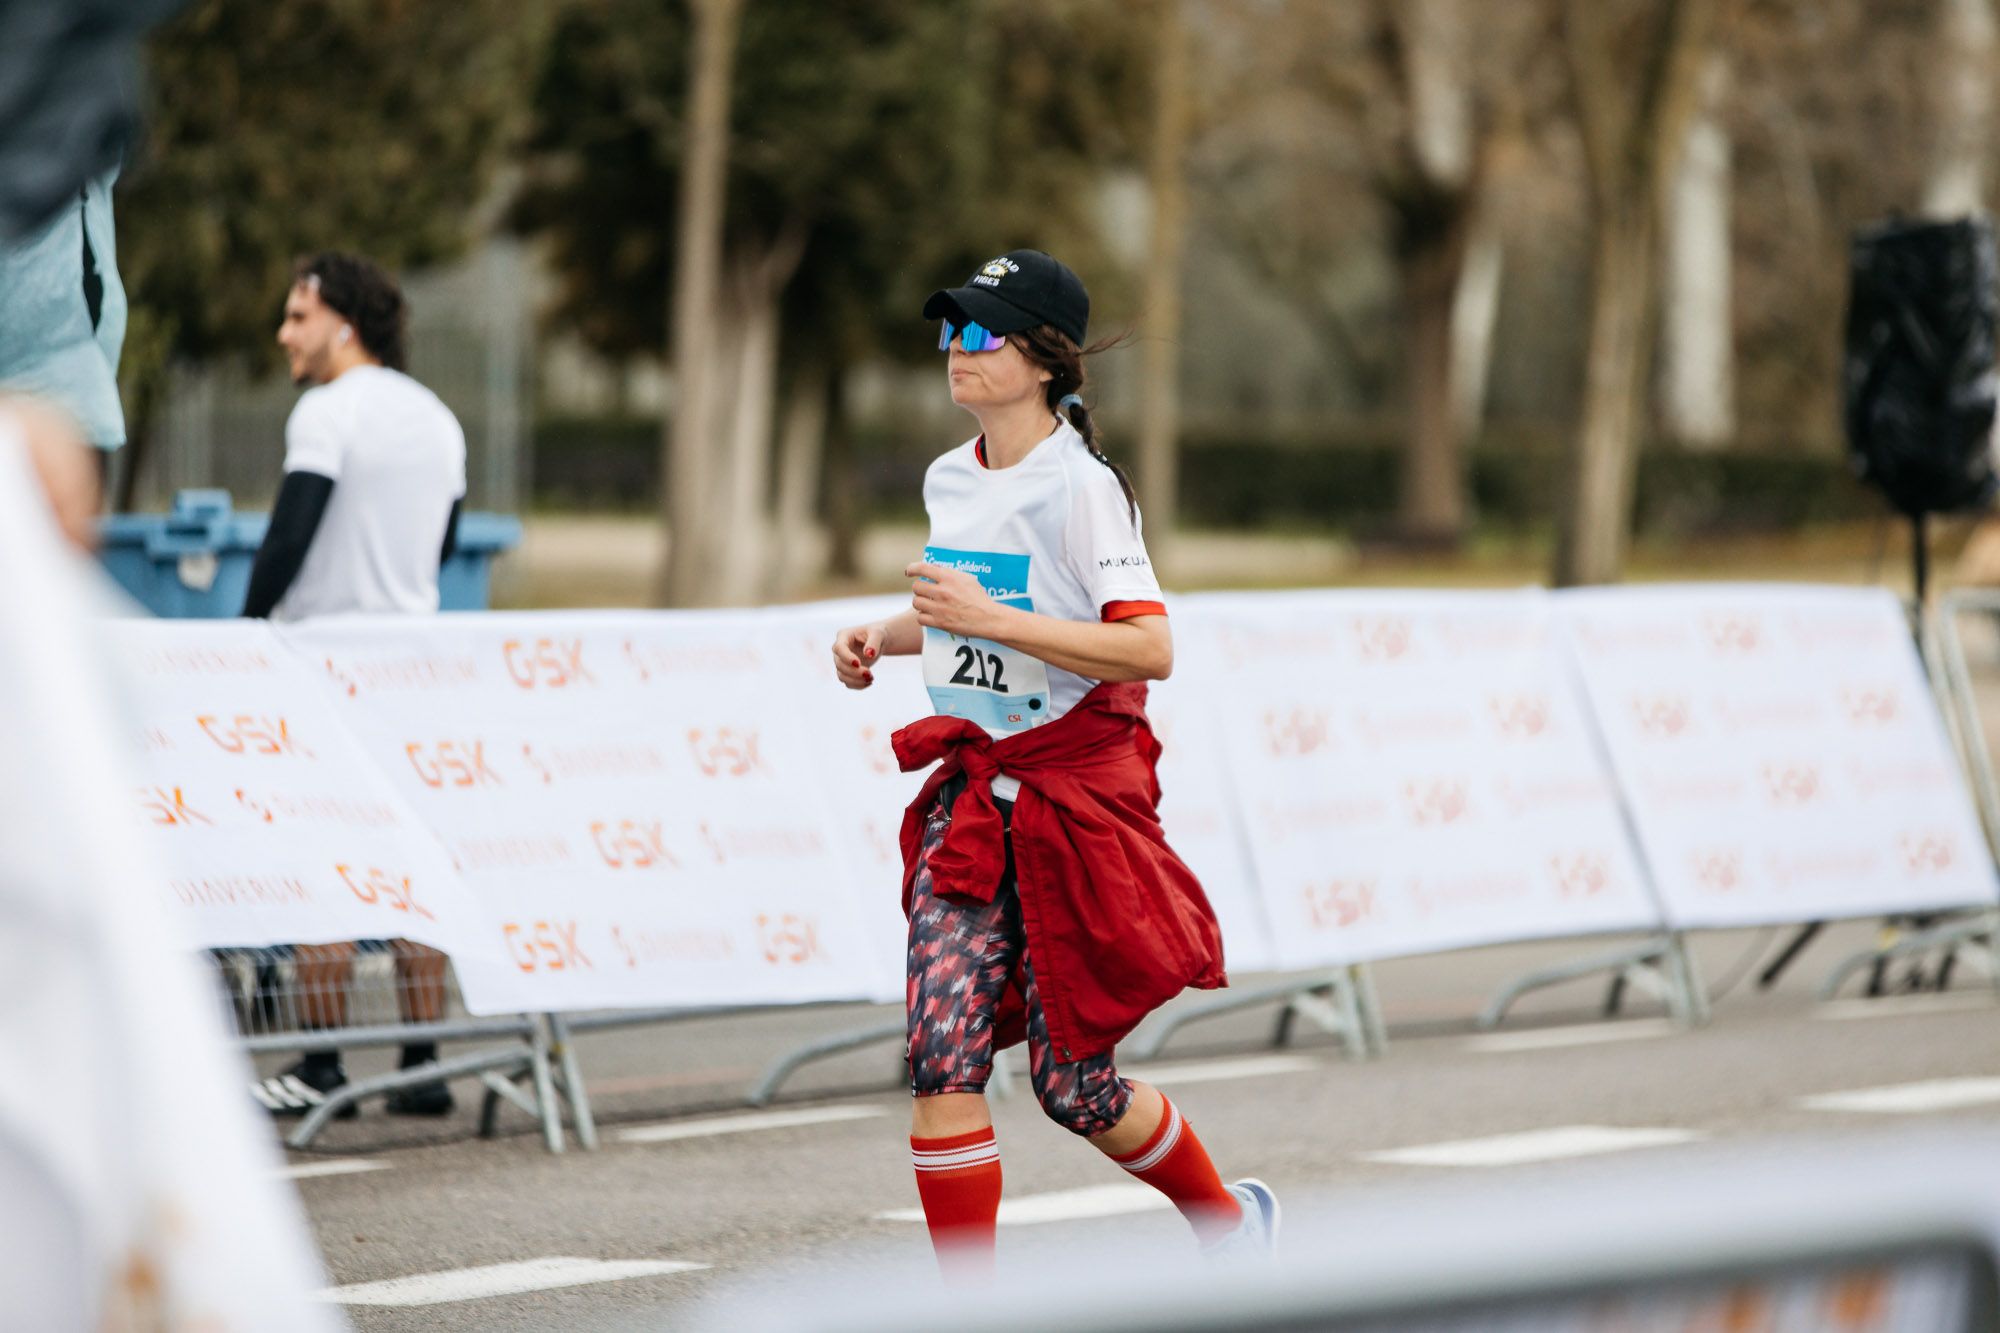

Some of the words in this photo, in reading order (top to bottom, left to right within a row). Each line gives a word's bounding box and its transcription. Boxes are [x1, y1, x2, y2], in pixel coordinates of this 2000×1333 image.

[956, 560, 992, 574] Solidaria
[502, 638, 593, 690] GSK
[949, 645, 1009, 693] 212
[196, 715, 312, 757] GSK
[1008, 714, 1023, 723] CSL
[405, 740, 500, 789] GSK
[588, 820, 678, 869] GSK
[335, 863, 435, 921] GSK
[502, 920, 593, 974] GSK
